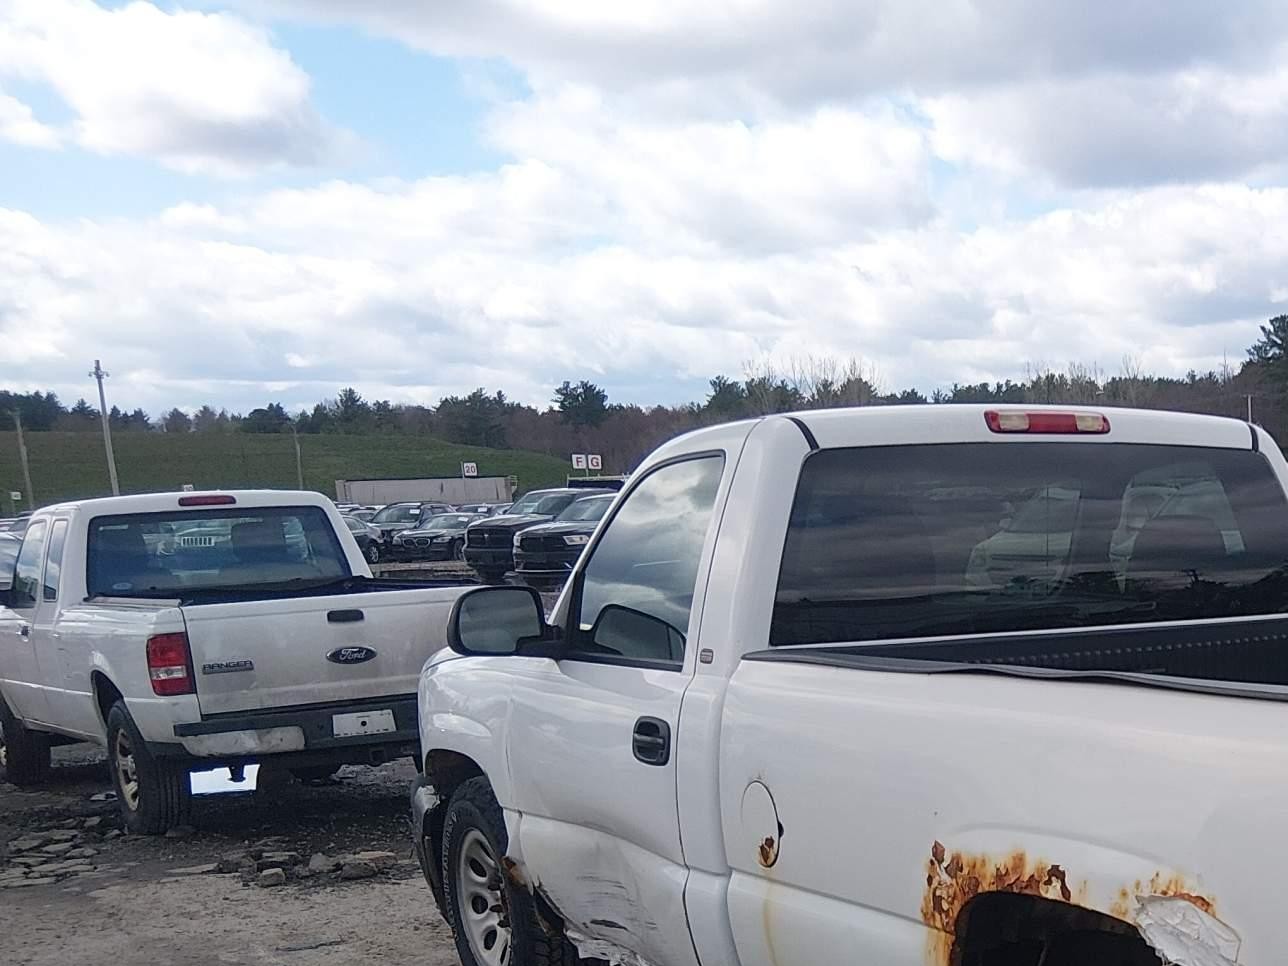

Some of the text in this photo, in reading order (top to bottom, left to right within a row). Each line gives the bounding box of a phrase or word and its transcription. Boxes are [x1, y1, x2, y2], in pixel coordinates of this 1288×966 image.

[576, 456, 583, 467] F
[591, 456, 600, 468] G
[465, 465, 476, 474] 20
[203, 660, 253, 671] RANGER
